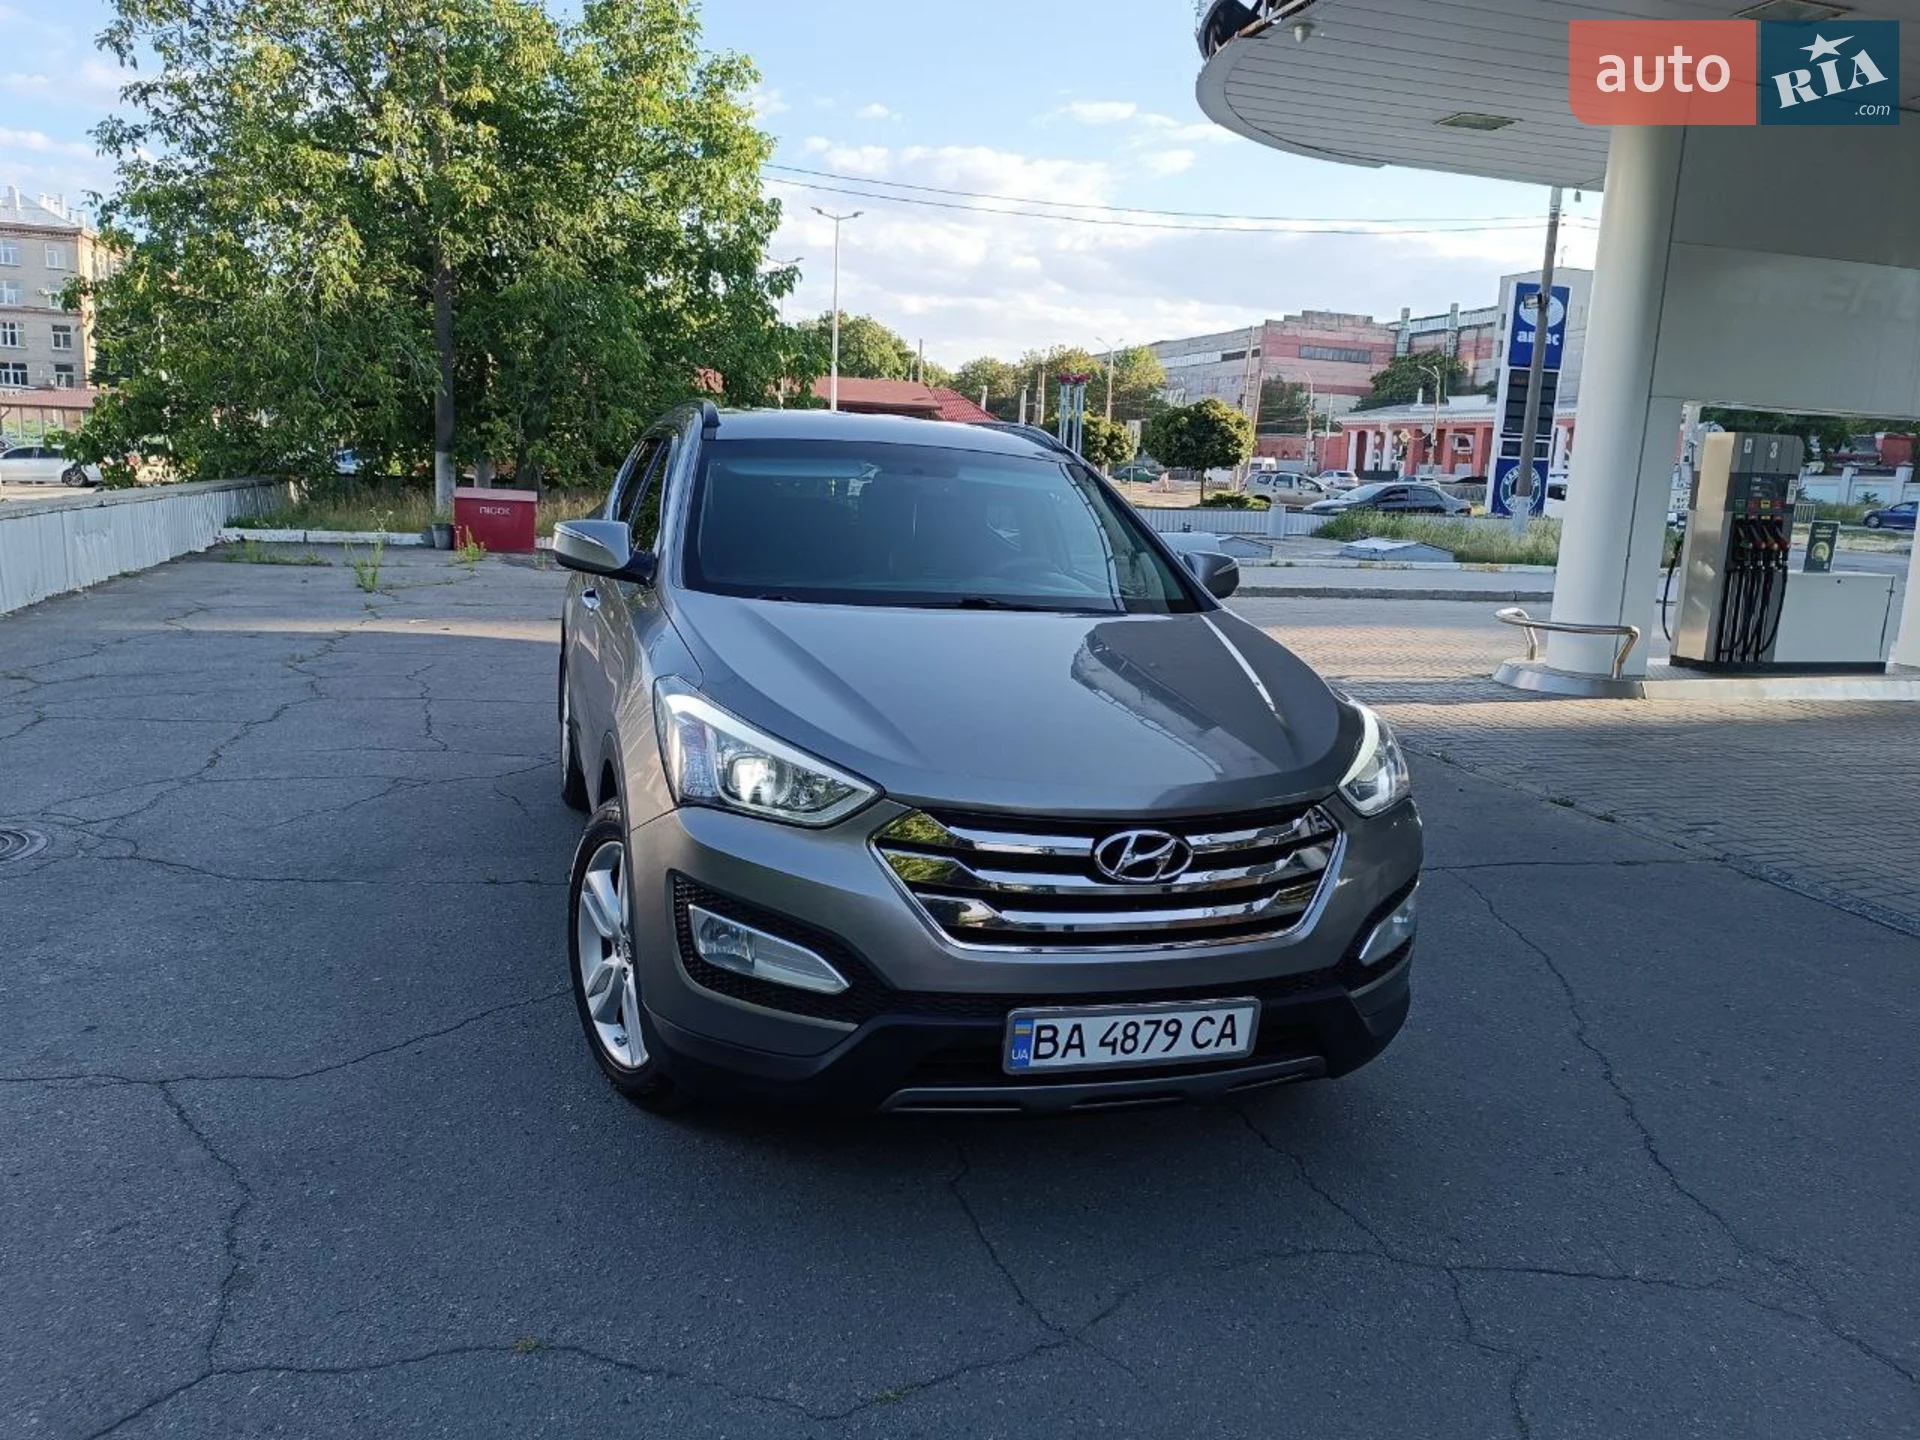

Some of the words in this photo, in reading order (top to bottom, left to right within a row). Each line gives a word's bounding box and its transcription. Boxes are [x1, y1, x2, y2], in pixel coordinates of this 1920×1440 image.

[1033, 1023, 1086, 1060] BA
[1099, 1018, 1183, 1056] 4879
[1191, 1013, 1237, 1050] CA
[1011, 1049, 1029, 1061] UA
